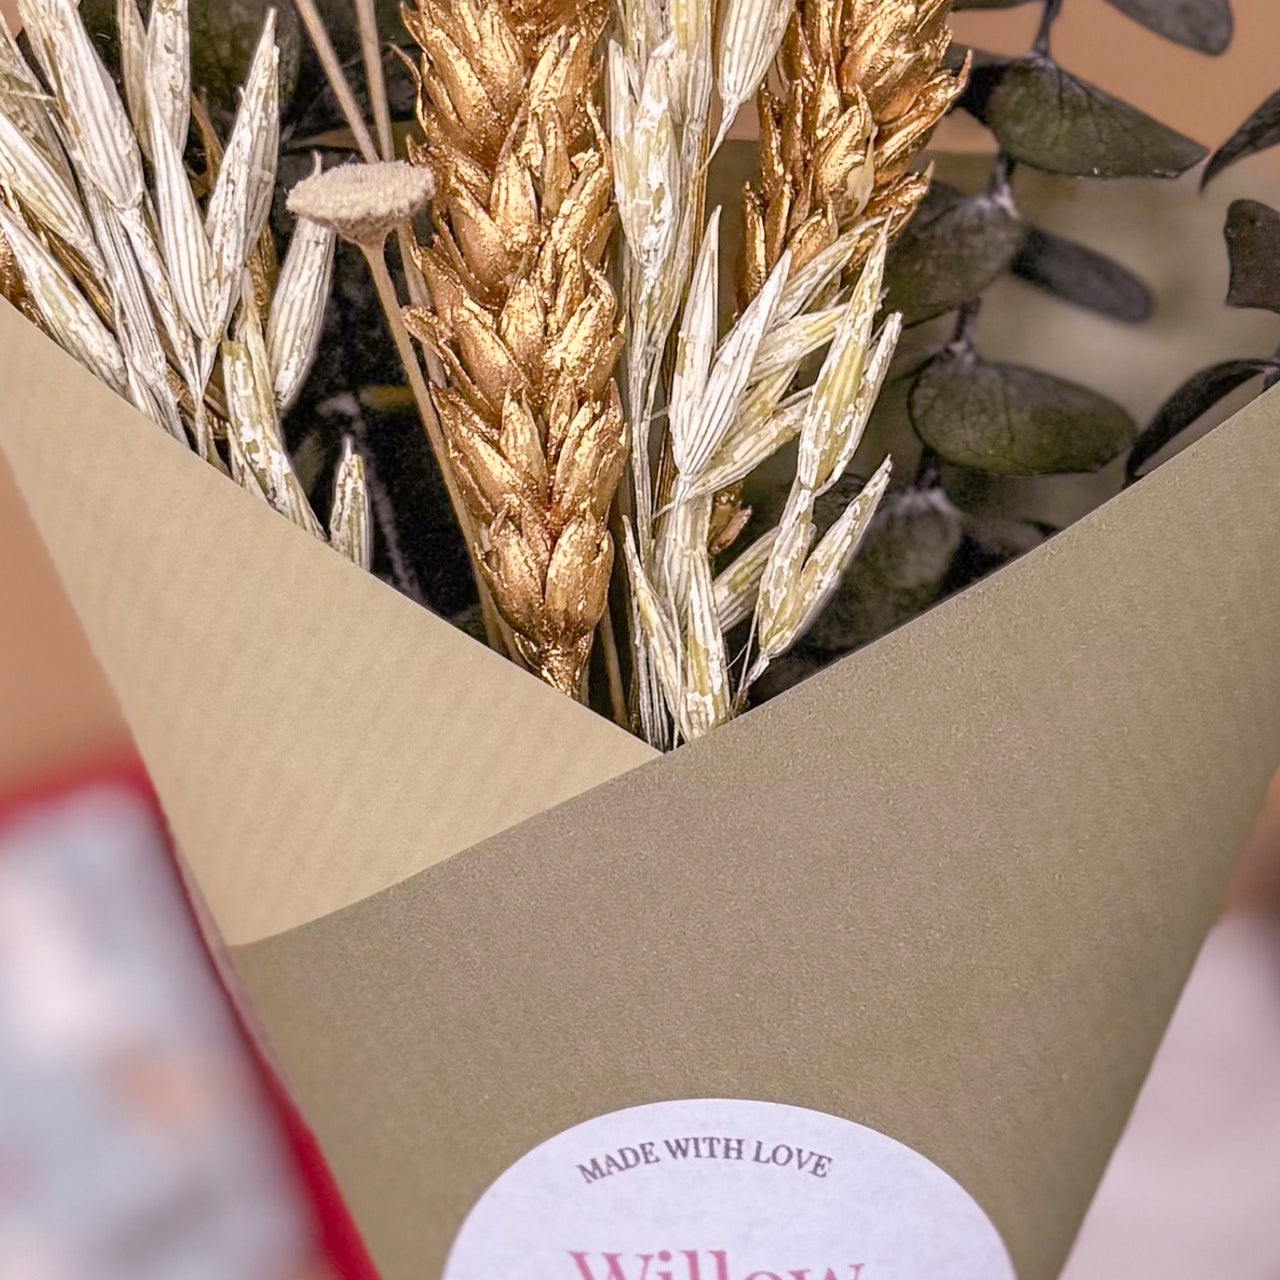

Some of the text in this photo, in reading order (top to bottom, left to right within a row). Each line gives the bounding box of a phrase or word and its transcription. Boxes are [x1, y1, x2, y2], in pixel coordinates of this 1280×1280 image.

[575, 1136, 832, 1183] MADE WITH LOVE
